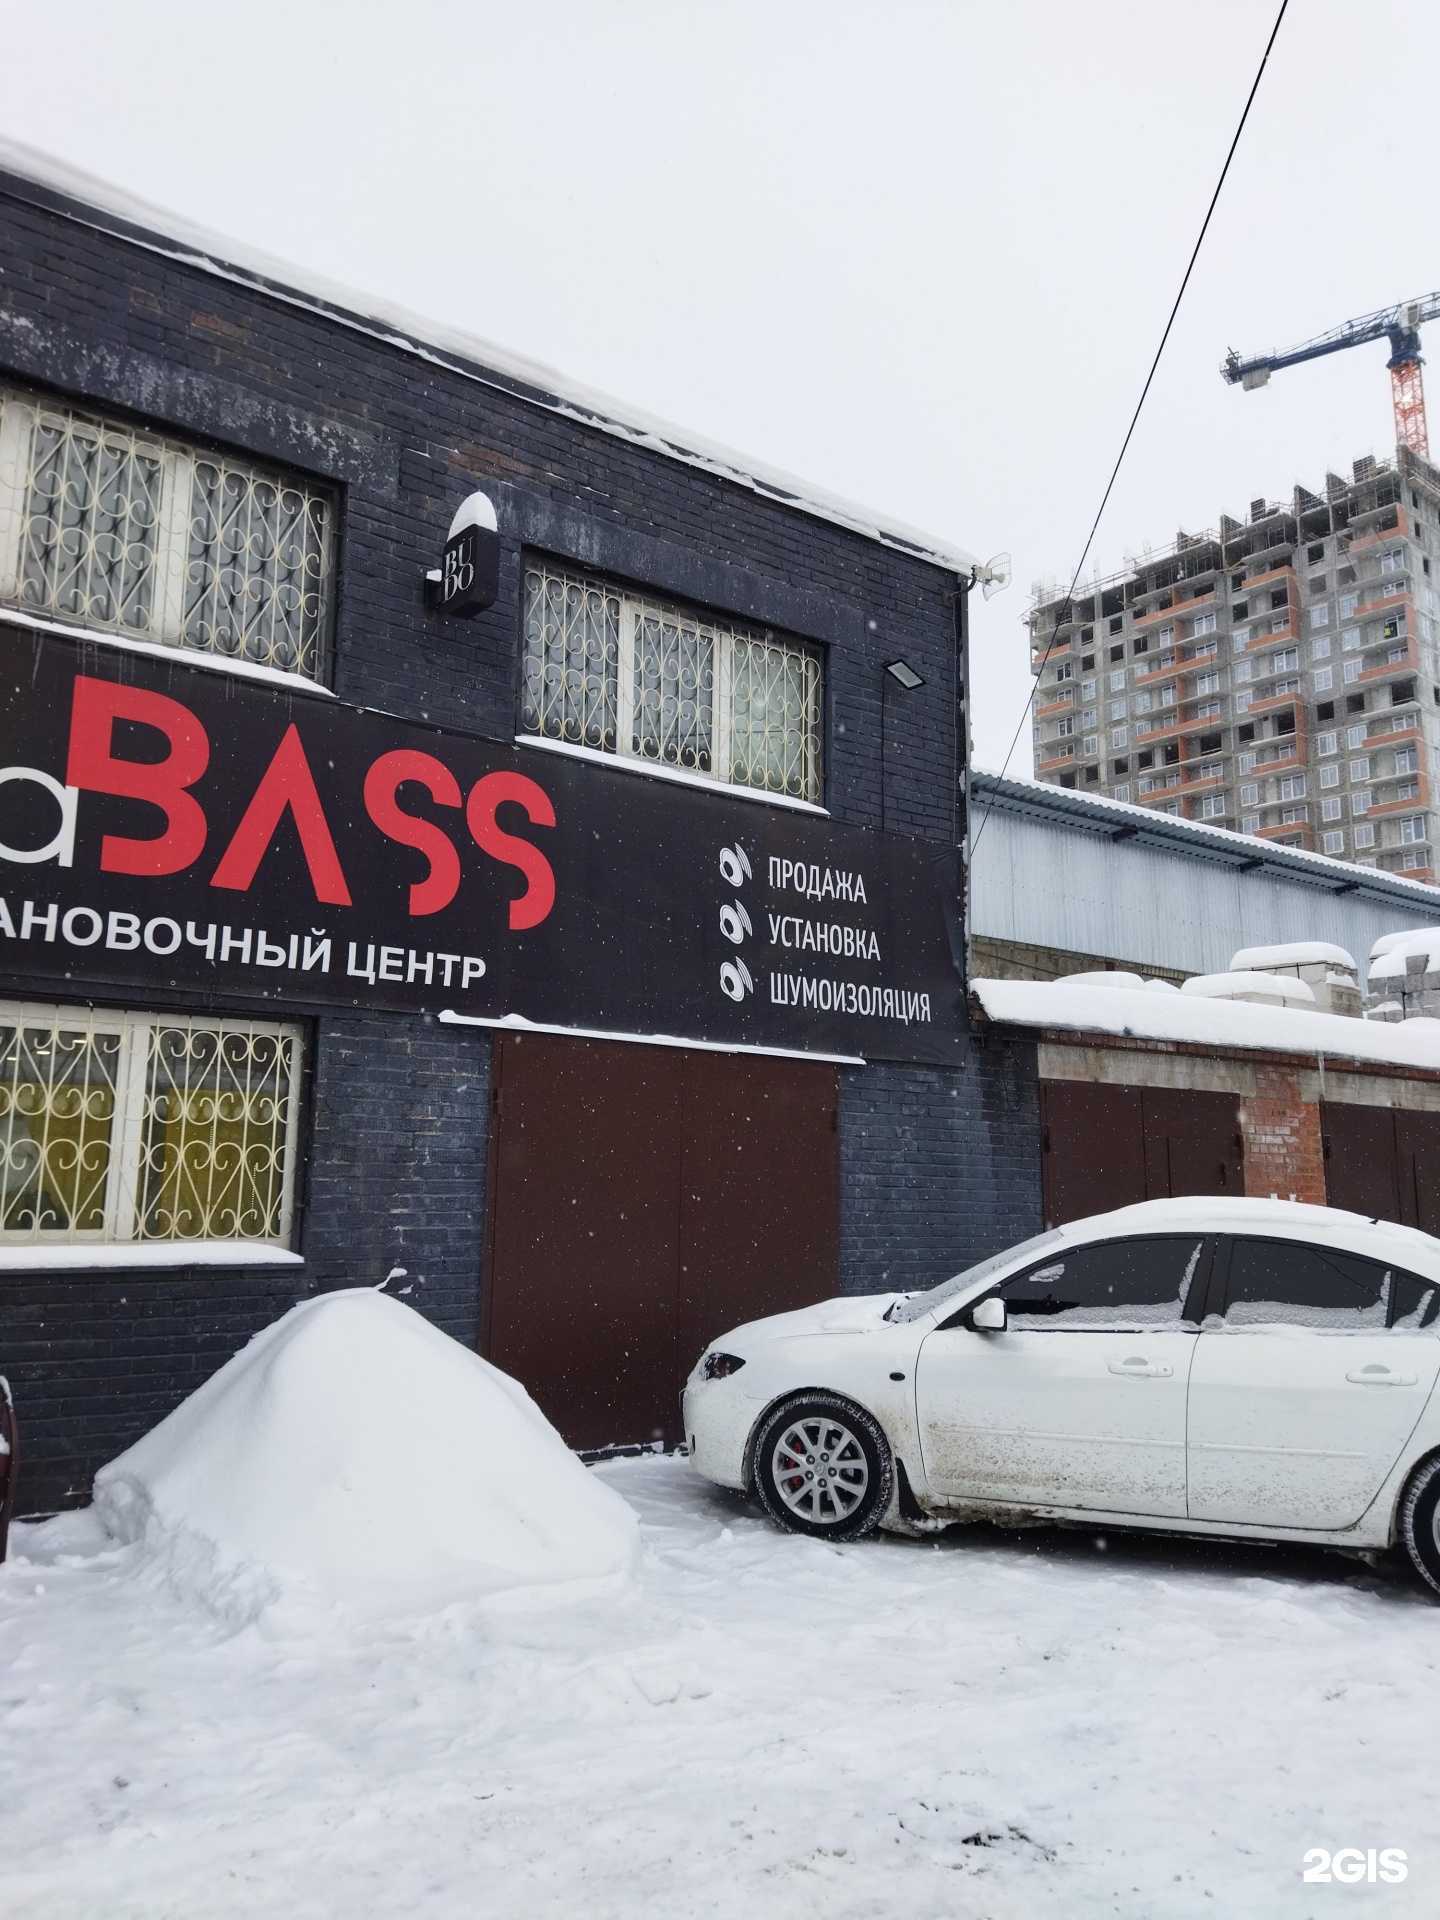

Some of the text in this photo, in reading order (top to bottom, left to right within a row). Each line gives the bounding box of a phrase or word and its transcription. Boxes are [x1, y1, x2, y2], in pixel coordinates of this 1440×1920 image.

[769, 856, 867, 904] ПРОДАЖА
[768, 914, 881, 961] УСТАНОВКА
[346, 943, 487, 989] ЦЕНТР
[770, 972, 932, 1025] ШУМОИЗОЛЯЦИЯ
